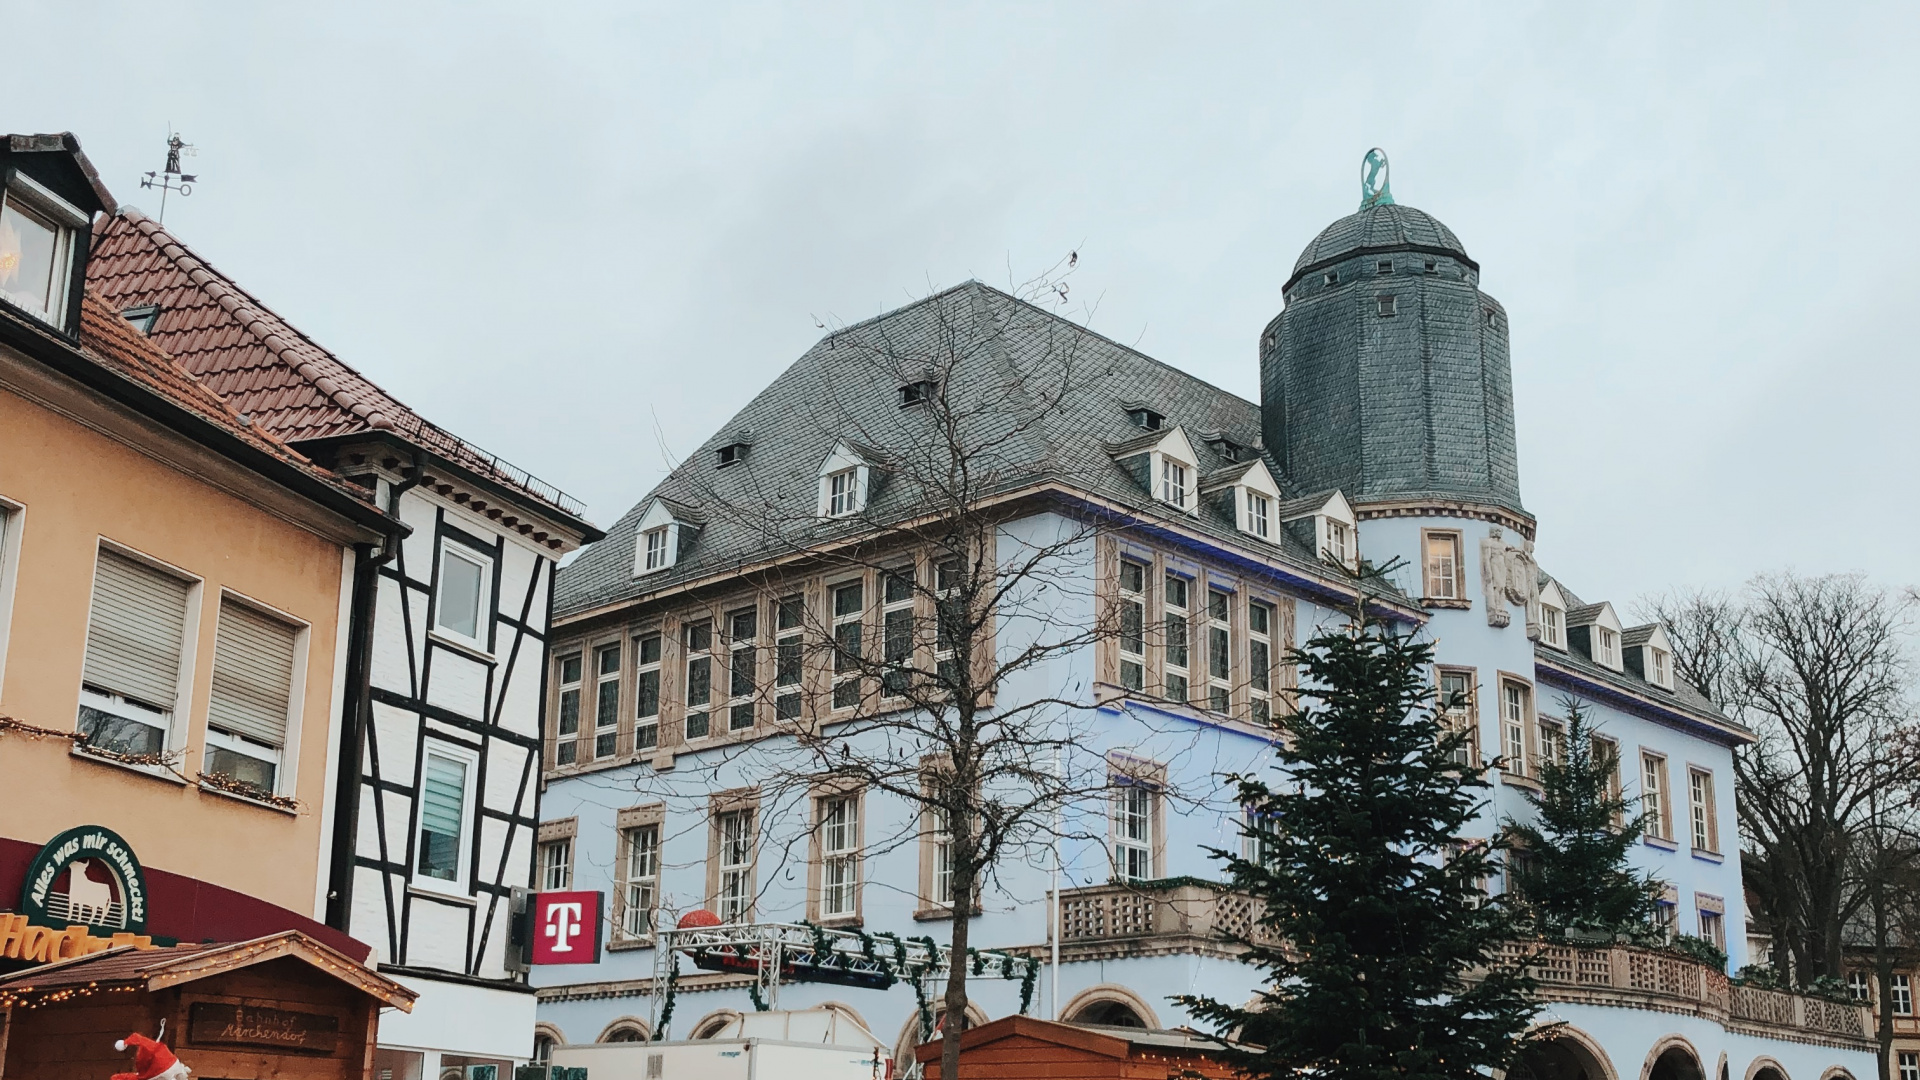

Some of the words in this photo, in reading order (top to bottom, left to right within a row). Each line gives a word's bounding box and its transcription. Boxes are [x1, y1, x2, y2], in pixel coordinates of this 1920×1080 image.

[31, 861, 55, 908] Alles
[53, 837, 80, 866] was
[82, 831, 108, 850] mir
[545, 902, 582, 952] T
[236, 1009, 296, 1027] Bahnhof
